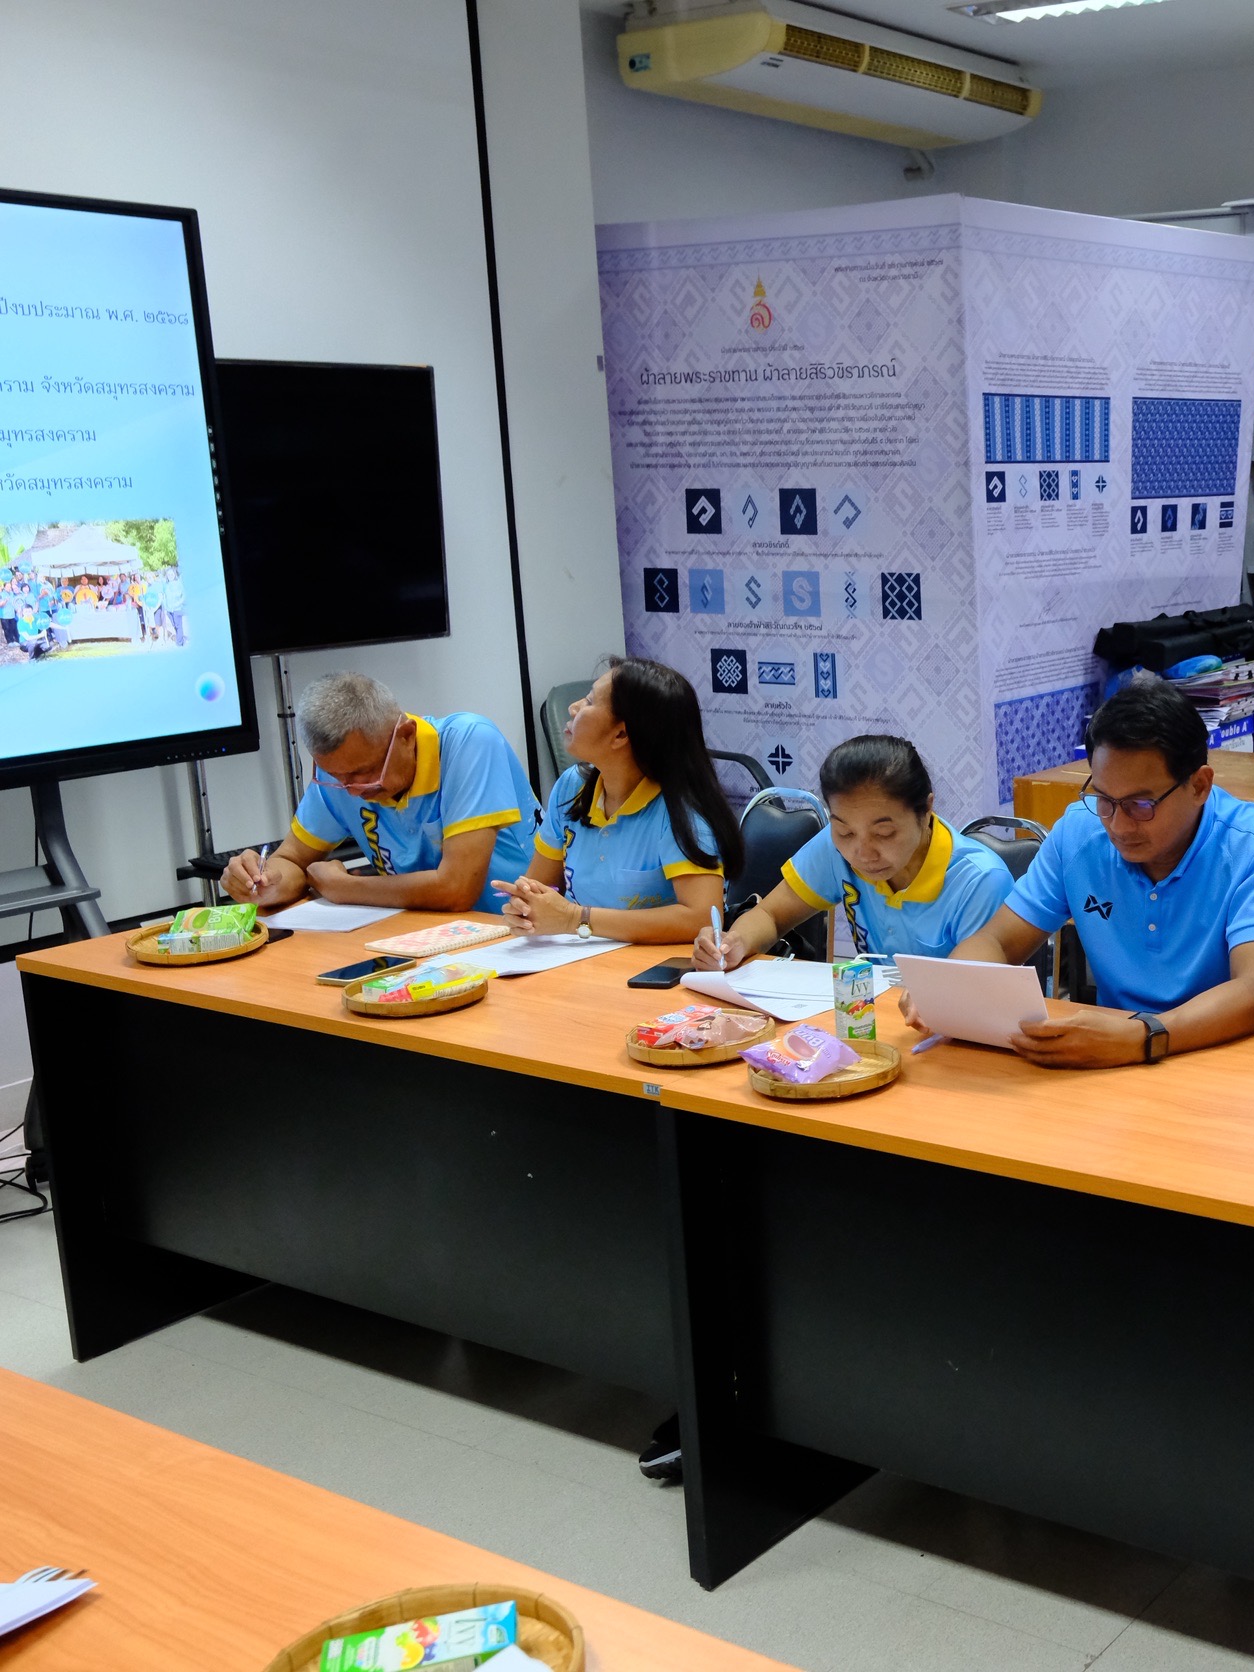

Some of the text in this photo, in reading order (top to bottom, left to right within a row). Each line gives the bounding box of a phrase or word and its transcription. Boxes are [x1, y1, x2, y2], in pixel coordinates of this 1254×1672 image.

[106, 307, 139, 323] พ.ศ.
[144, 309, 190, 326] ๒๕๖๘
[640, 366, 758, 386] ผ้าลายพระราชทาน
[41, 375, 195, 401] จังหวัดสมุทรสงคราม
